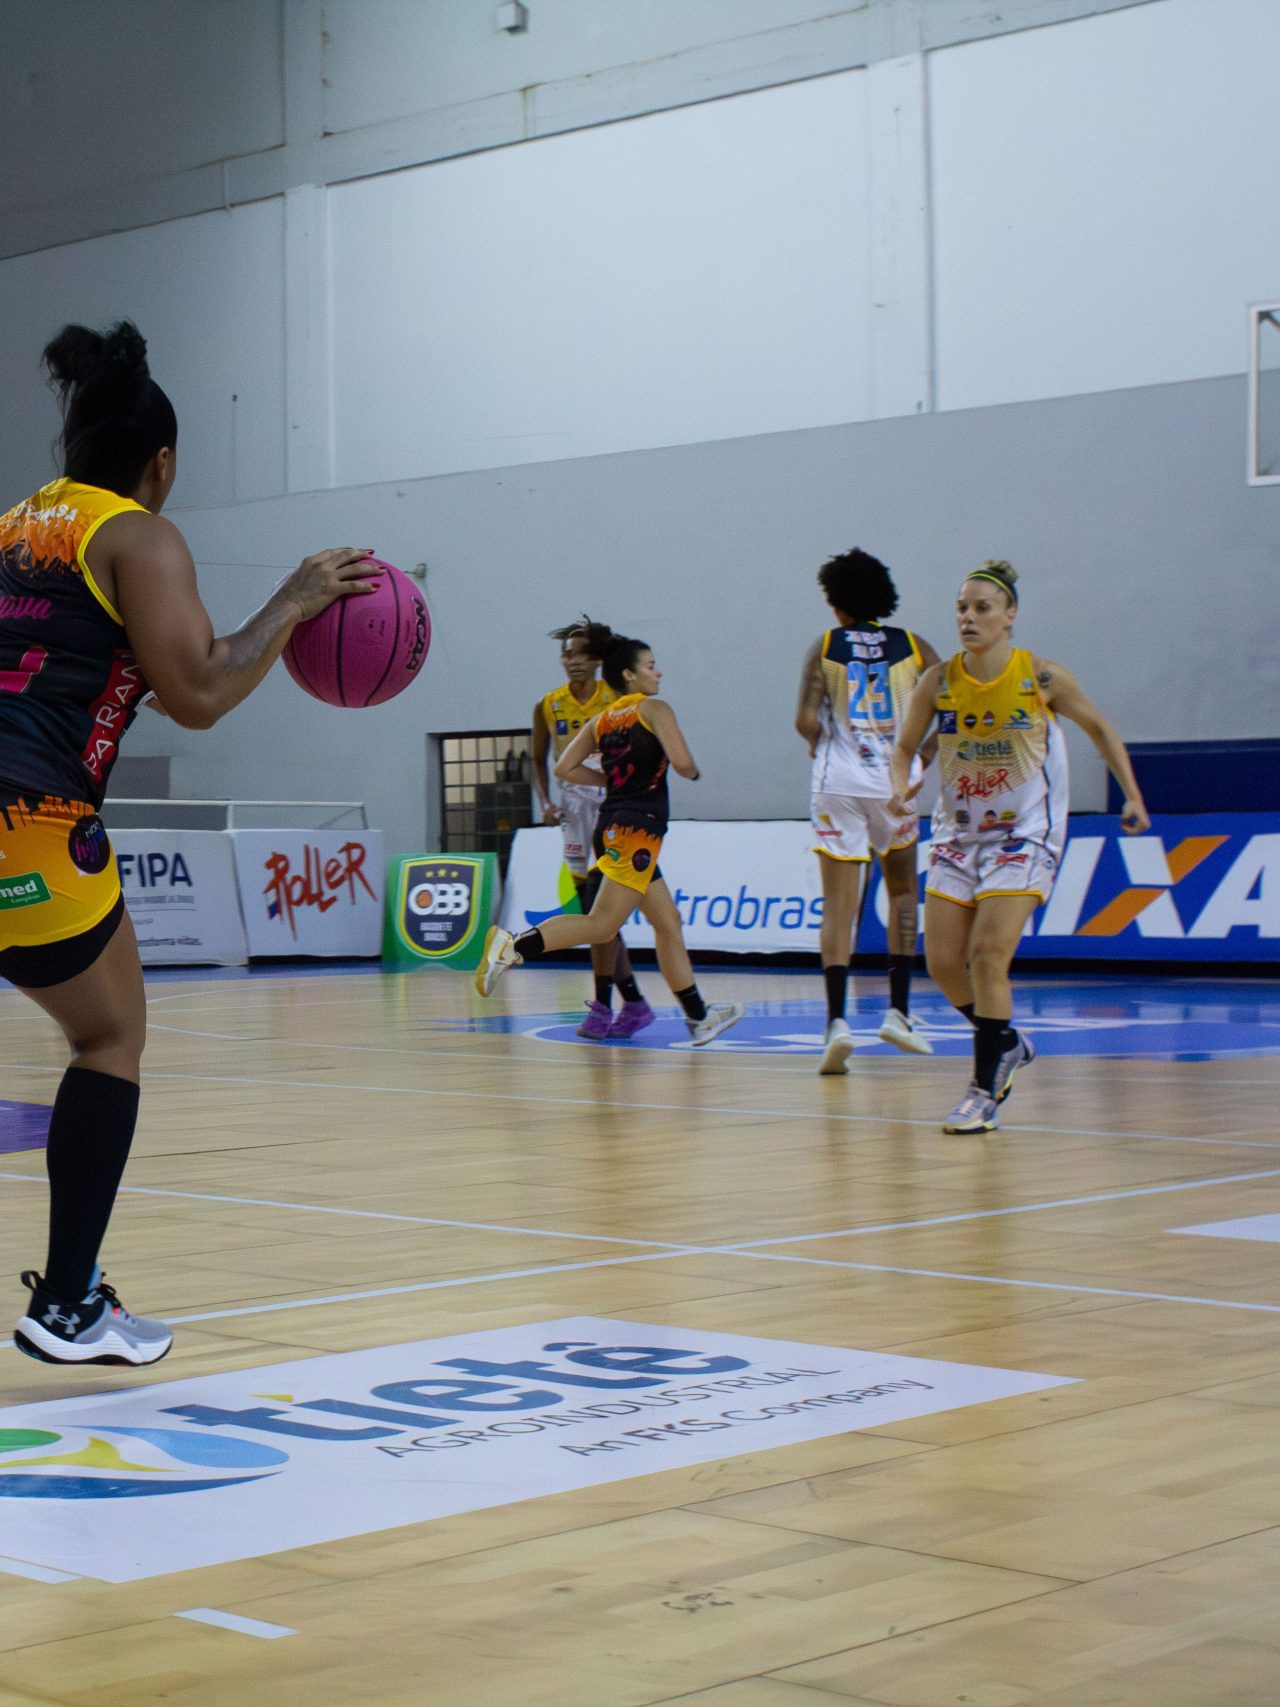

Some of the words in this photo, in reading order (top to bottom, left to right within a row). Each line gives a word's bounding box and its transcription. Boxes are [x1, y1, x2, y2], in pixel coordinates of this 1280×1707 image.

[847, 661, 894, 720] 23
[116, 852, 193, 888] FIPA
[624, 884, 826, 931] trobras
[156, 1341, 752, 1442] tietê
[375, 1366, 841, 1458] AGROINDUSTRIAL
[557, 1438, 637, 1457] An
[622, 1417, 726, 1443] FKS
[720, 1377, 936, 1421] Company
